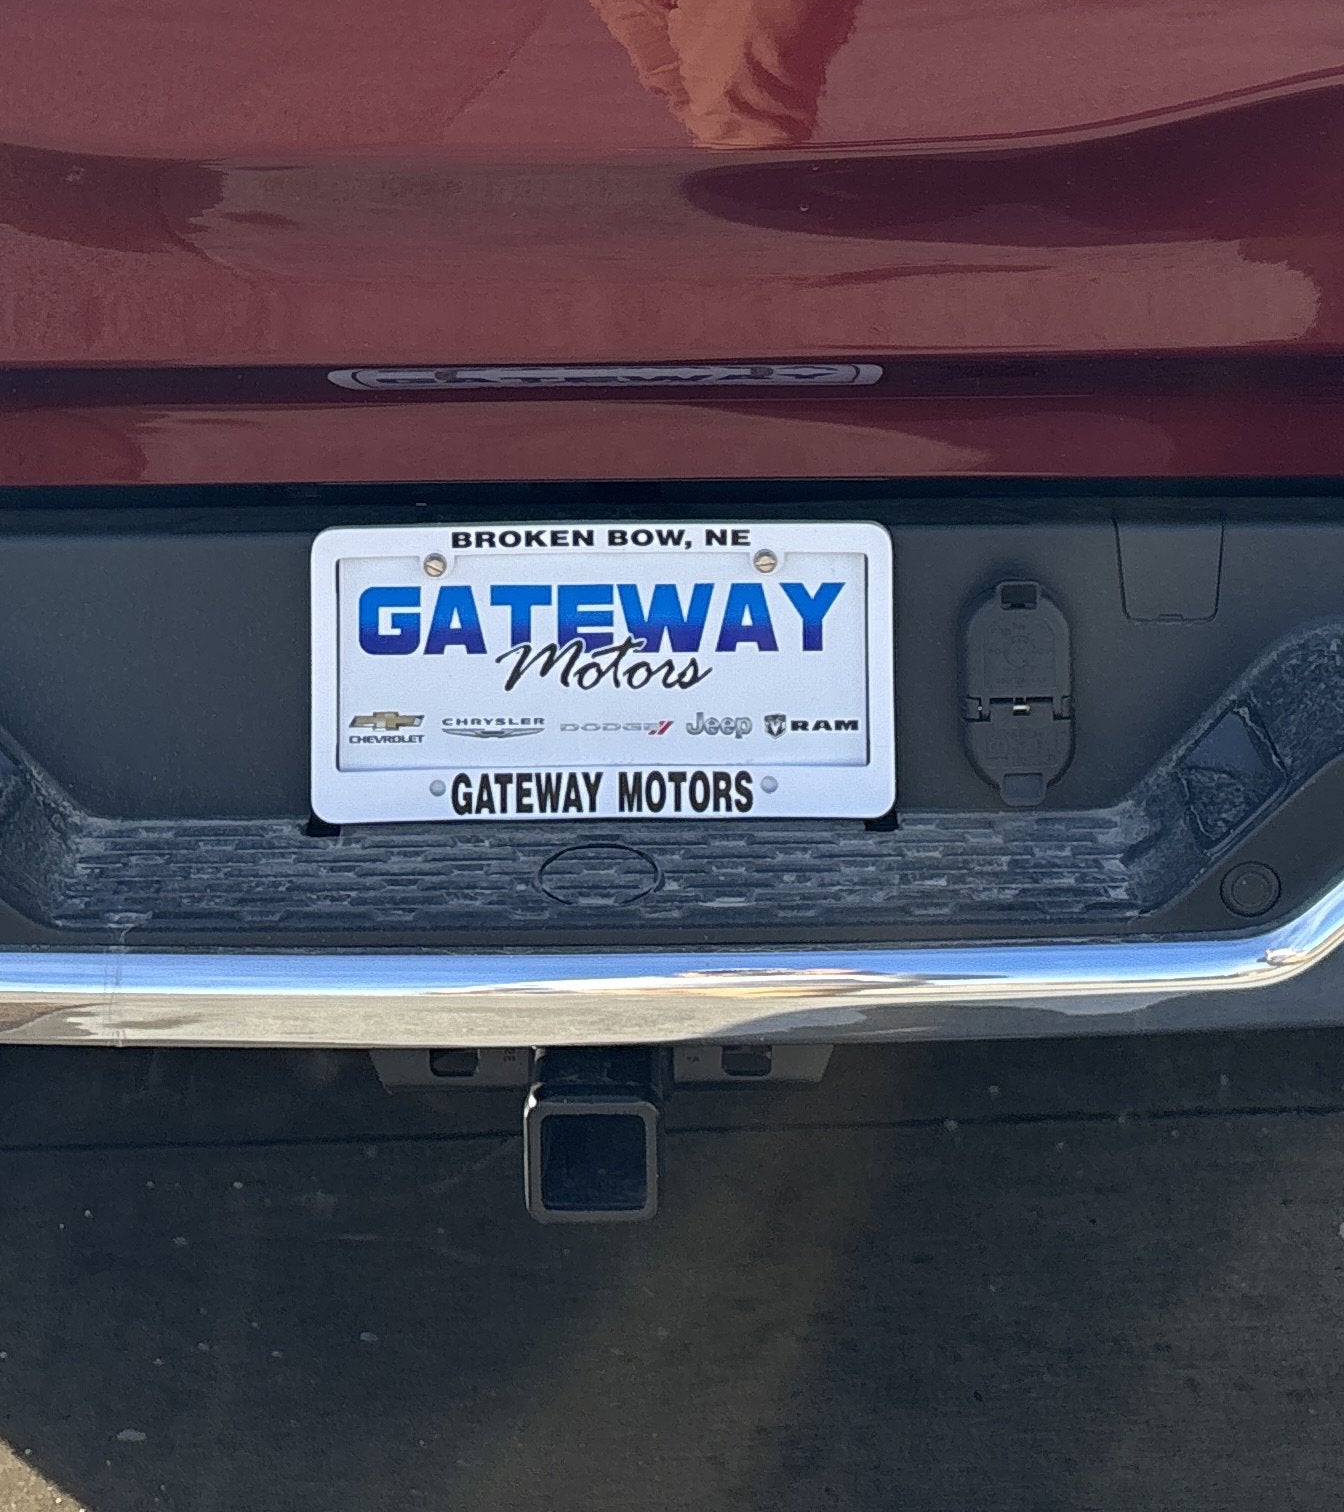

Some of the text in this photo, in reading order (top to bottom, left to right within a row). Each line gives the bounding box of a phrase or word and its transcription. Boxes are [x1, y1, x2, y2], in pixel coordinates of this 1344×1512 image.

[450, 528, 752, 551] BROKEN BOW, NE
[358, 582, 846, 657] GATEWAY
[495, 635, 714, 692] Motors
[441, 717, 546, 726] CHRYSLER
[559, 722, 661, 732] DODGE
[685, 711, 753, 739] Jeep
[790, 719, 860, 732] RAM
[348, 734, 425, 744] CHEVROLET
[451, 771, 754, 817] GATEWAY MOTORS
